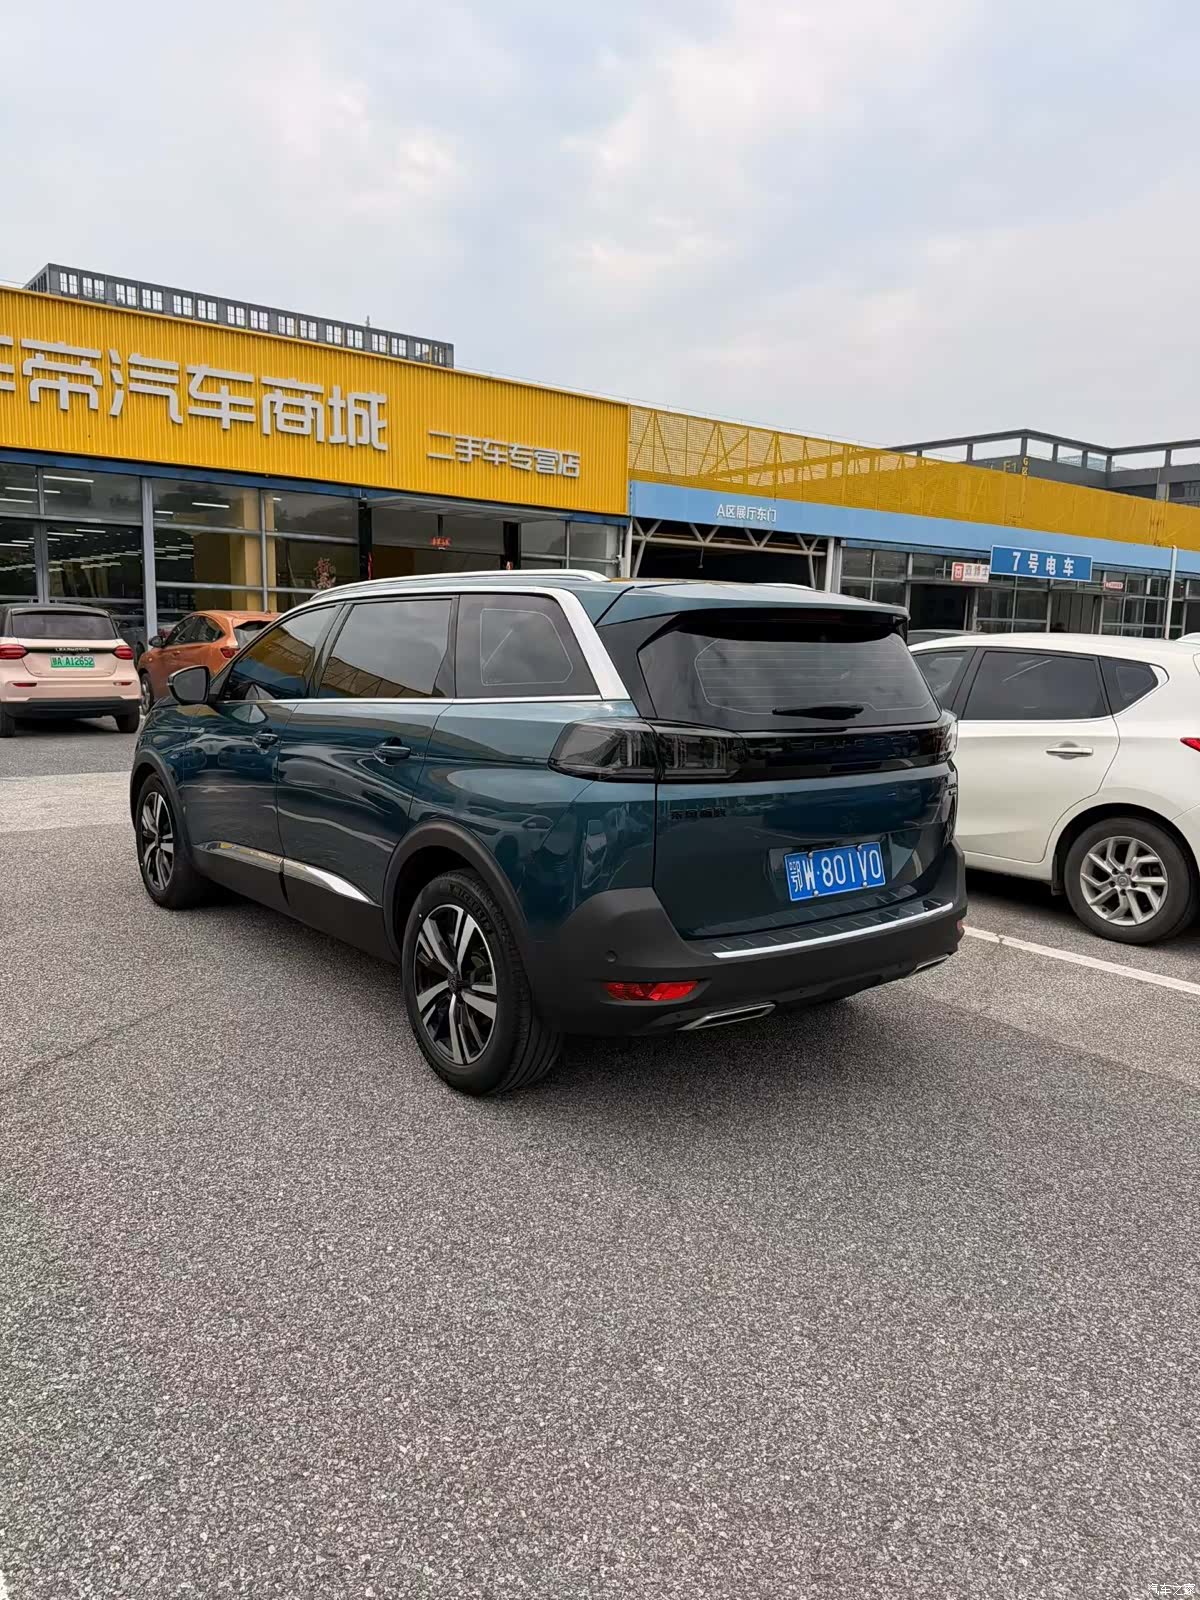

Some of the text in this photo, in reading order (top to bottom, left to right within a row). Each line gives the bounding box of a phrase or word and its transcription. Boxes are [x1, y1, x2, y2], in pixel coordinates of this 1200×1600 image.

[0, 336, 388, 450] 帝汽车商城
[427, 430, 581, 478] 二手车专营店
[716, 503, 777, 522] A区展厅东门
[1012, 551, 1075, 577] 7号电车
